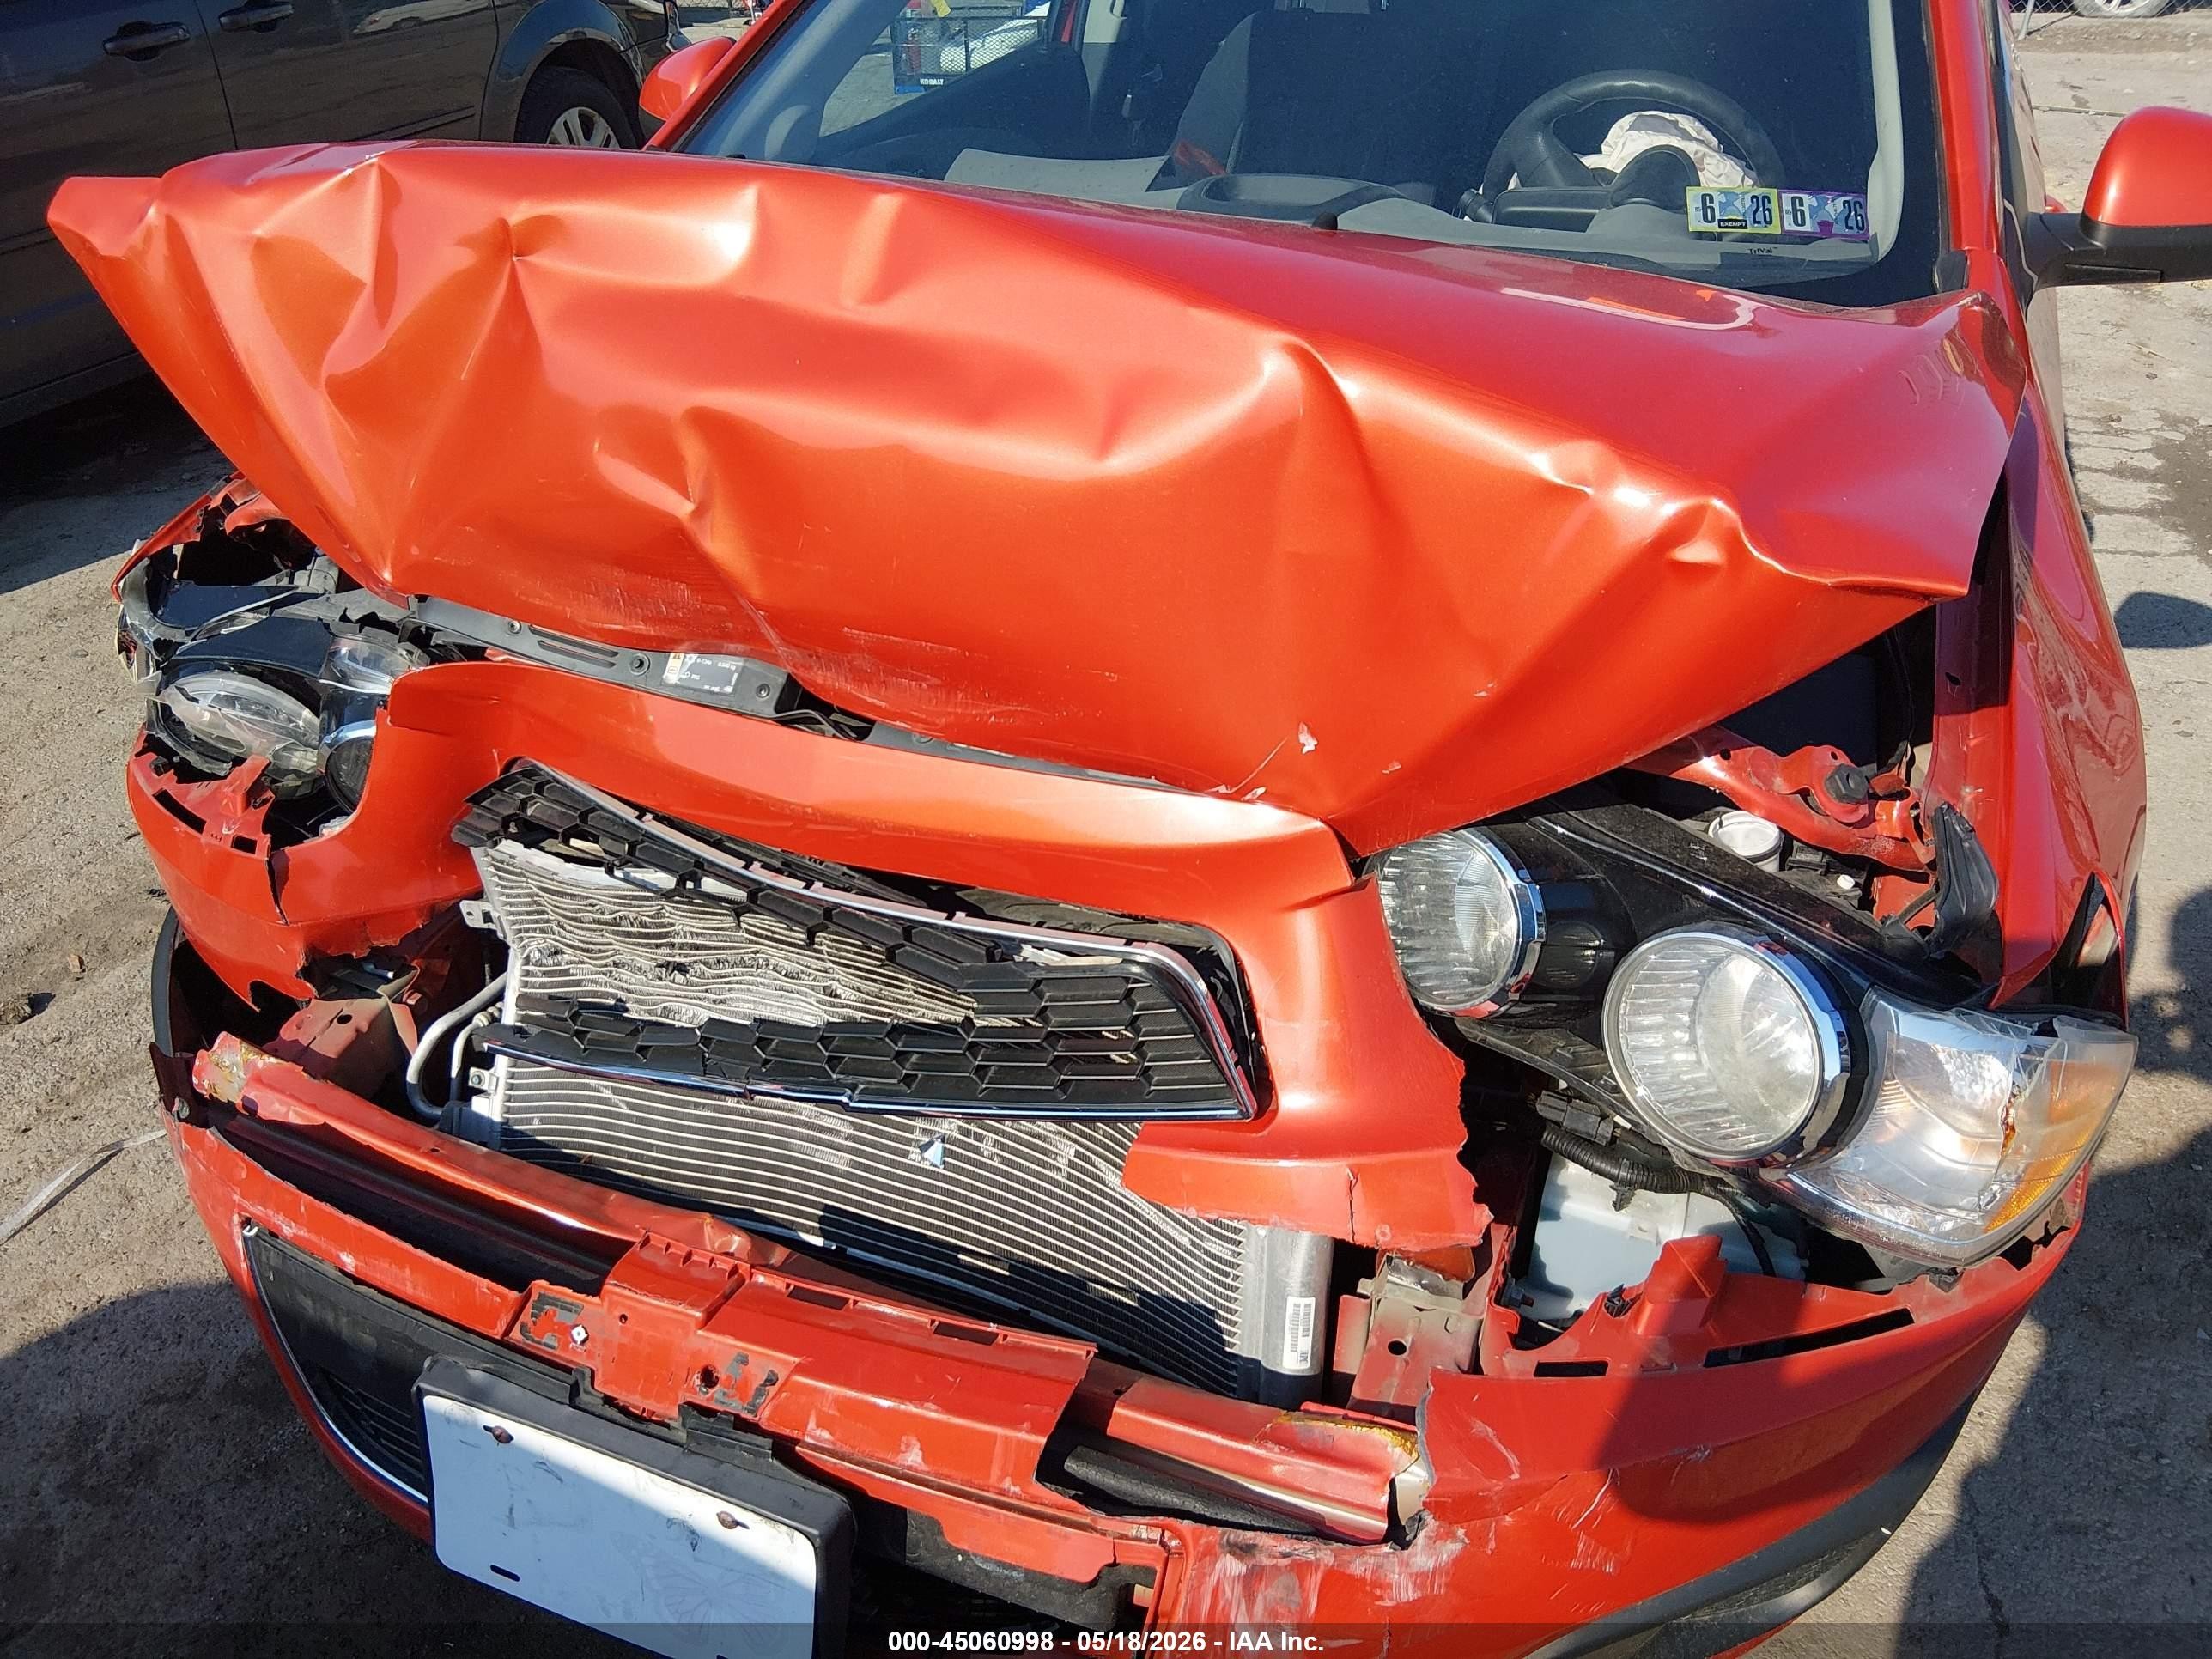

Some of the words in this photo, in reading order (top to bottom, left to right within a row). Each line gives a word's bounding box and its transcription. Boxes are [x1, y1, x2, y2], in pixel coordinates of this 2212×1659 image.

[1701, 193, 1716, 223] 6
[1750, 194, 1773, 225] 26
[1790, 196, 1806, 227] 6
[1842, 199, 1865, 231] 26
